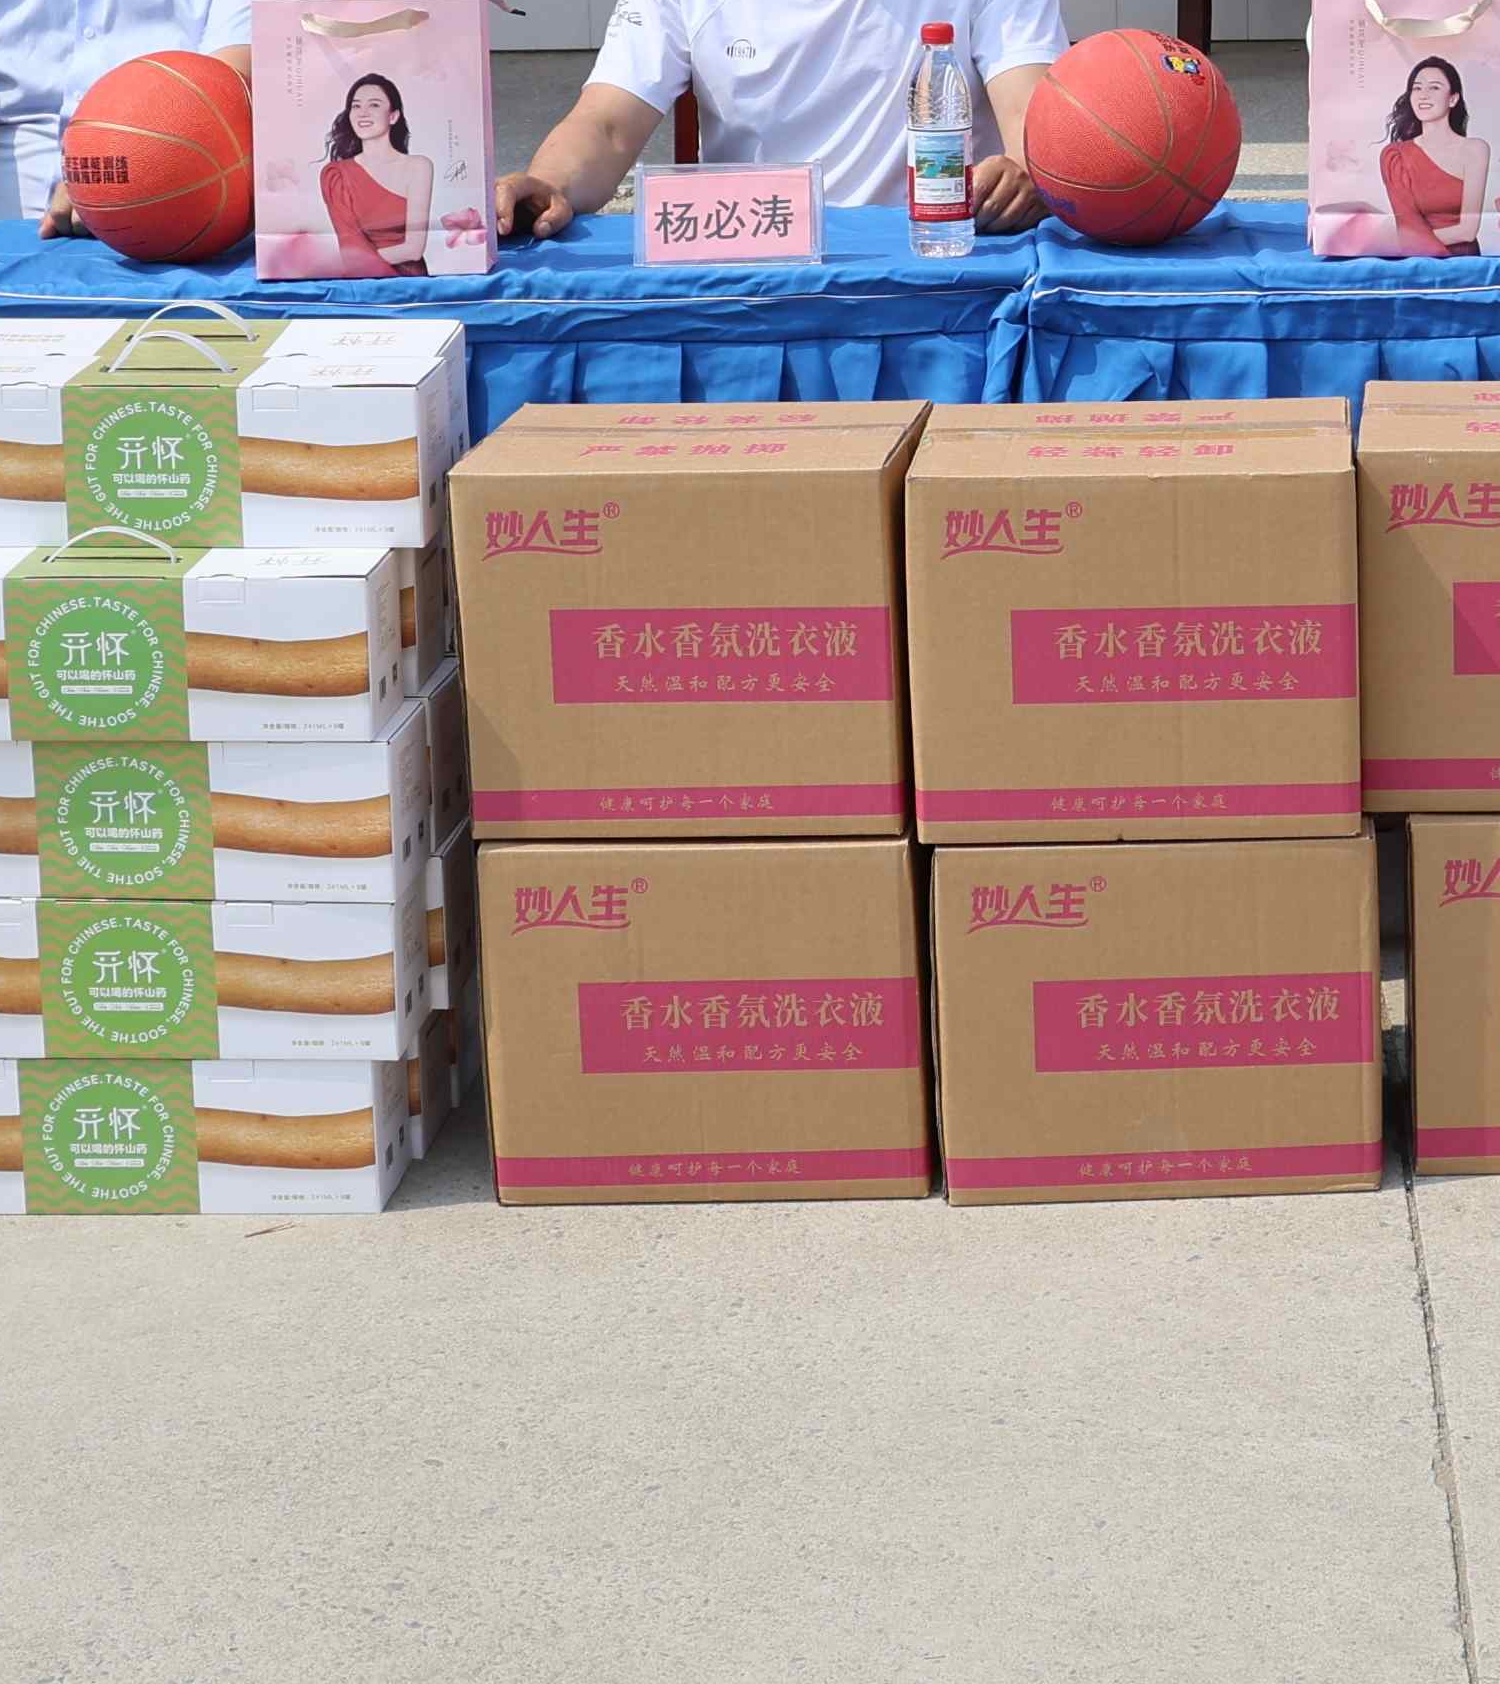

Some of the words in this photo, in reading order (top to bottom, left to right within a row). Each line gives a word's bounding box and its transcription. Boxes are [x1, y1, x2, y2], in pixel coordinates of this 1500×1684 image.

[655, 195, 793, 244] 杨必涛
[148, 402, 192, 426] TASTE
[192, 424, 212, 450] FOR
[85, 444, 98, 470] FOR
[87, 476, 106, 502] GUT
[104, 502, 129, 524] THE
[134, 512, 191, 530] SOOTHE
[595, 620, 858, 658] 香水香氛洗衣液
[1057, 619, 1321, 660] 香水香氛洗衣液
[612, 673, 835, 695] 天然温和配方更安全
[1075, 668, 1300, 692] 天然温和配方更安全
[124, 917, 168, 940] TASTE
[168, 939, 189, 965] FOR
[61, 958, 74, 984] FOR
[63, 990, 83, 1015] GUT
[624, 992, 885, 1030] 香水香氛洗衣液
[1078, 988, 1340, 1027] 香水香氛洗衣液
[82, 1015, 105, 1037] THE
[111, 1025, 167, 1043] SOOTHE
[643, 1042, 863, 1062] 天然温和配方更安全
[1096, 1037, 1317, 1059] 天然温和配方更安全
